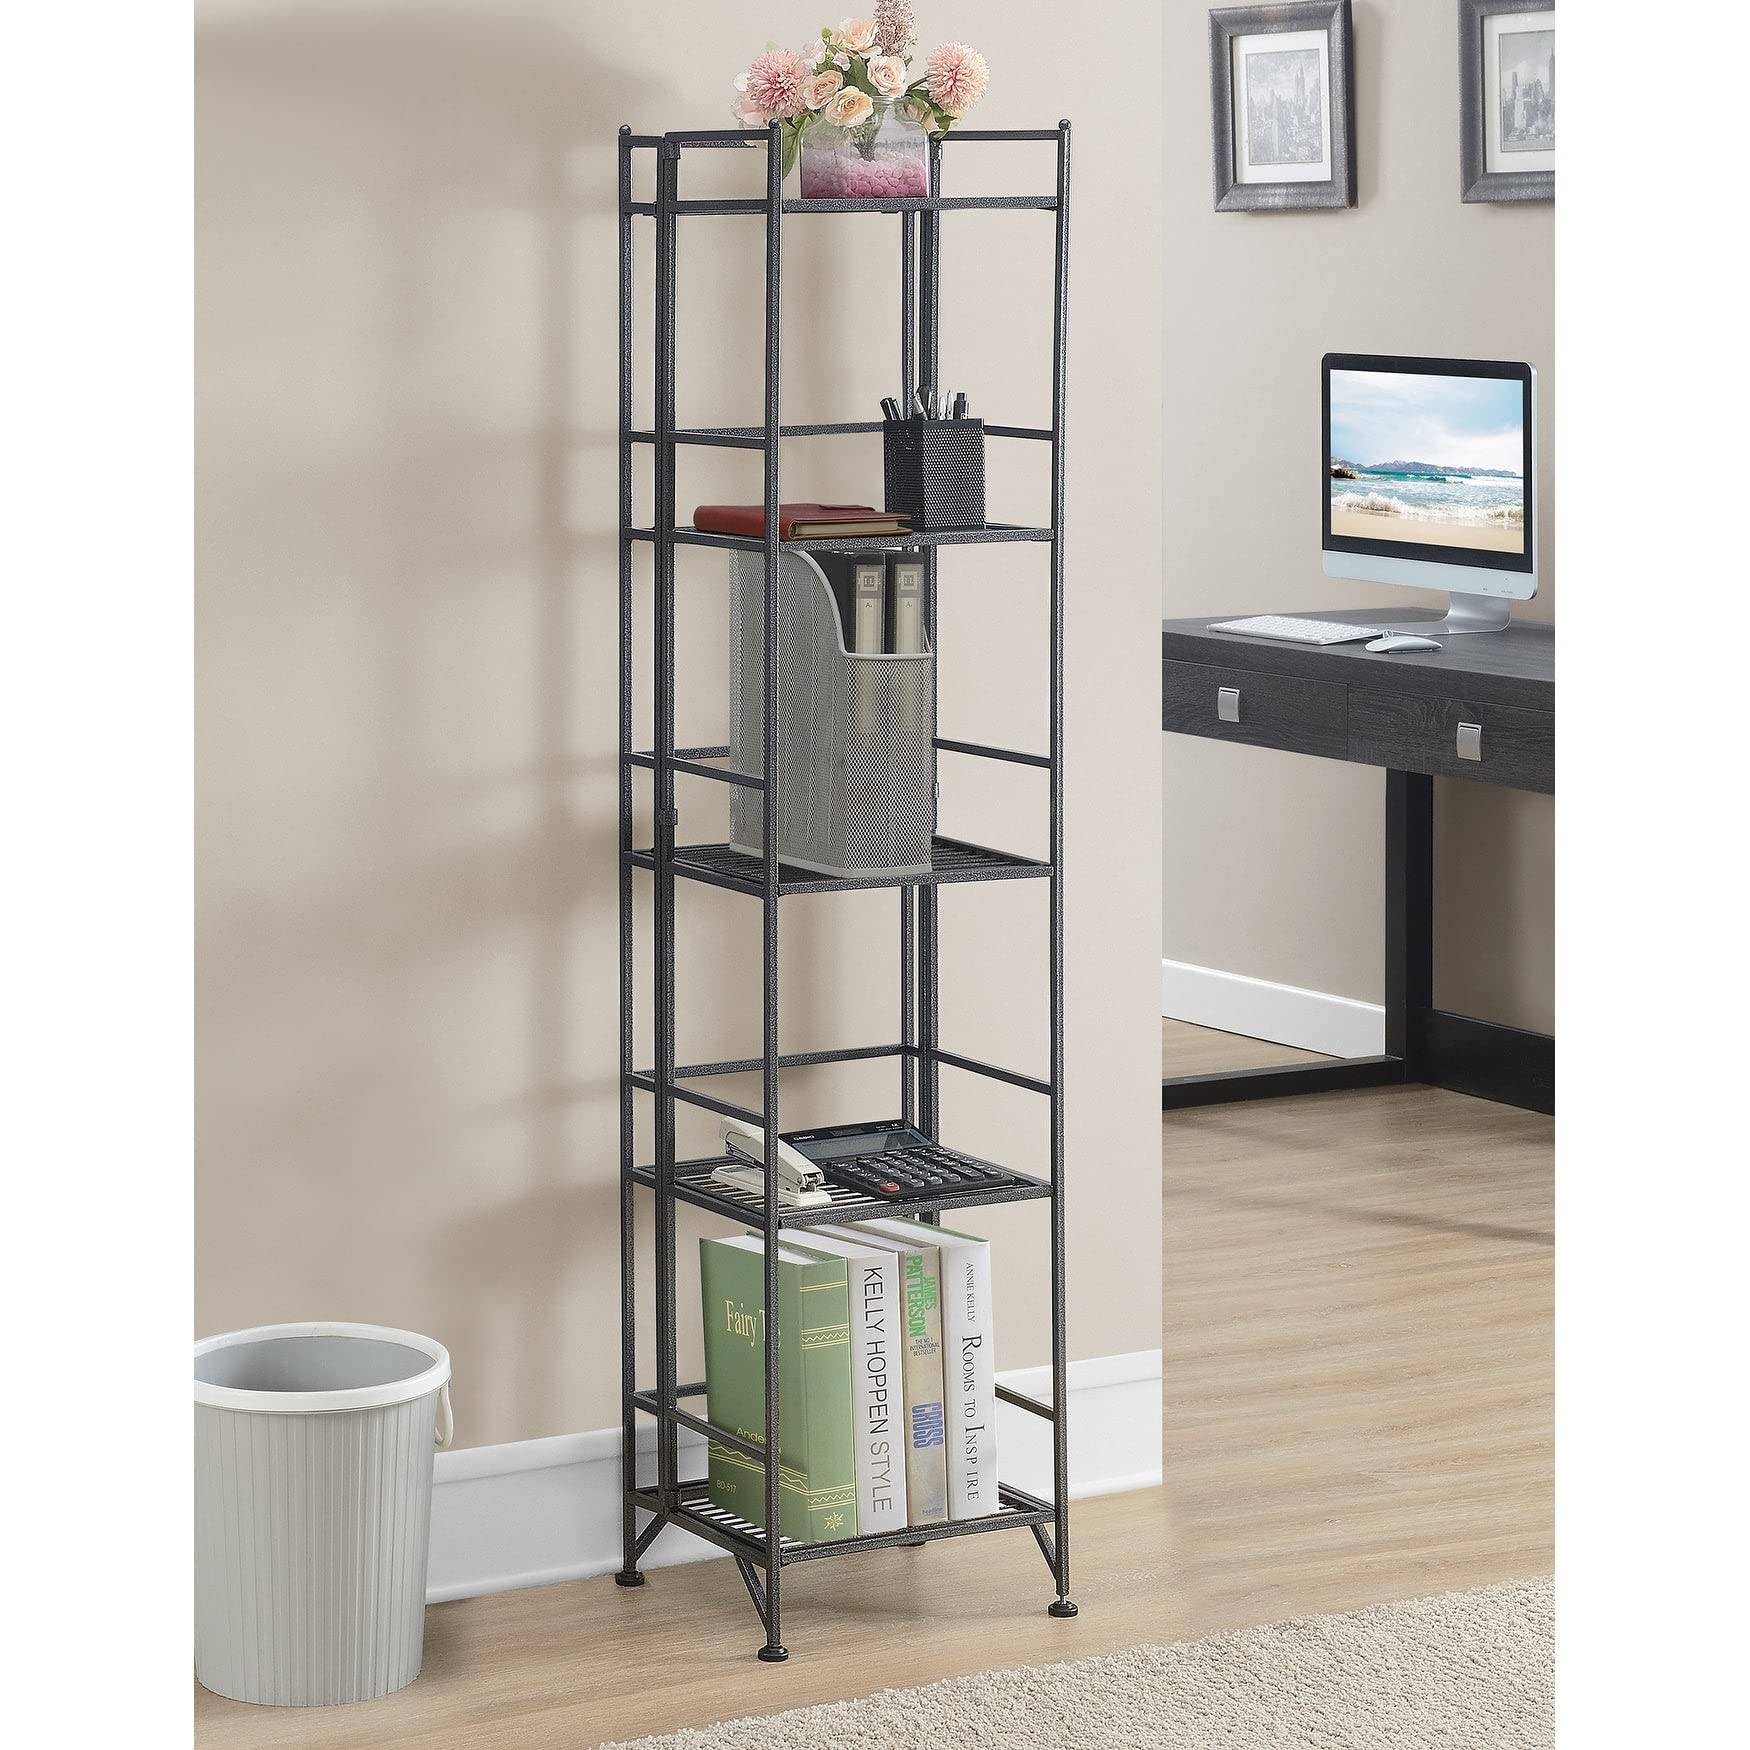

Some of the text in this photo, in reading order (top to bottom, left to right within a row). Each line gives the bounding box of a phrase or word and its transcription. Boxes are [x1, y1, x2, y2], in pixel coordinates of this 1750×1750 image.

[906, 1254, 926, 1338] PATTERSON
[924, 1276, 937, 1311] JAMES
[965, 1262, 976, 1322] ANNIE KELLY
[725, 1300, 757, 1348] Fairy
[863, 1267, 893, 1513] KELLY HOPPEN STYLE
[964, 1399, 977, 1418] TO
[736, 1427, 767, 1445] Ande
[912, 1401, 944, 1449] CROSS
